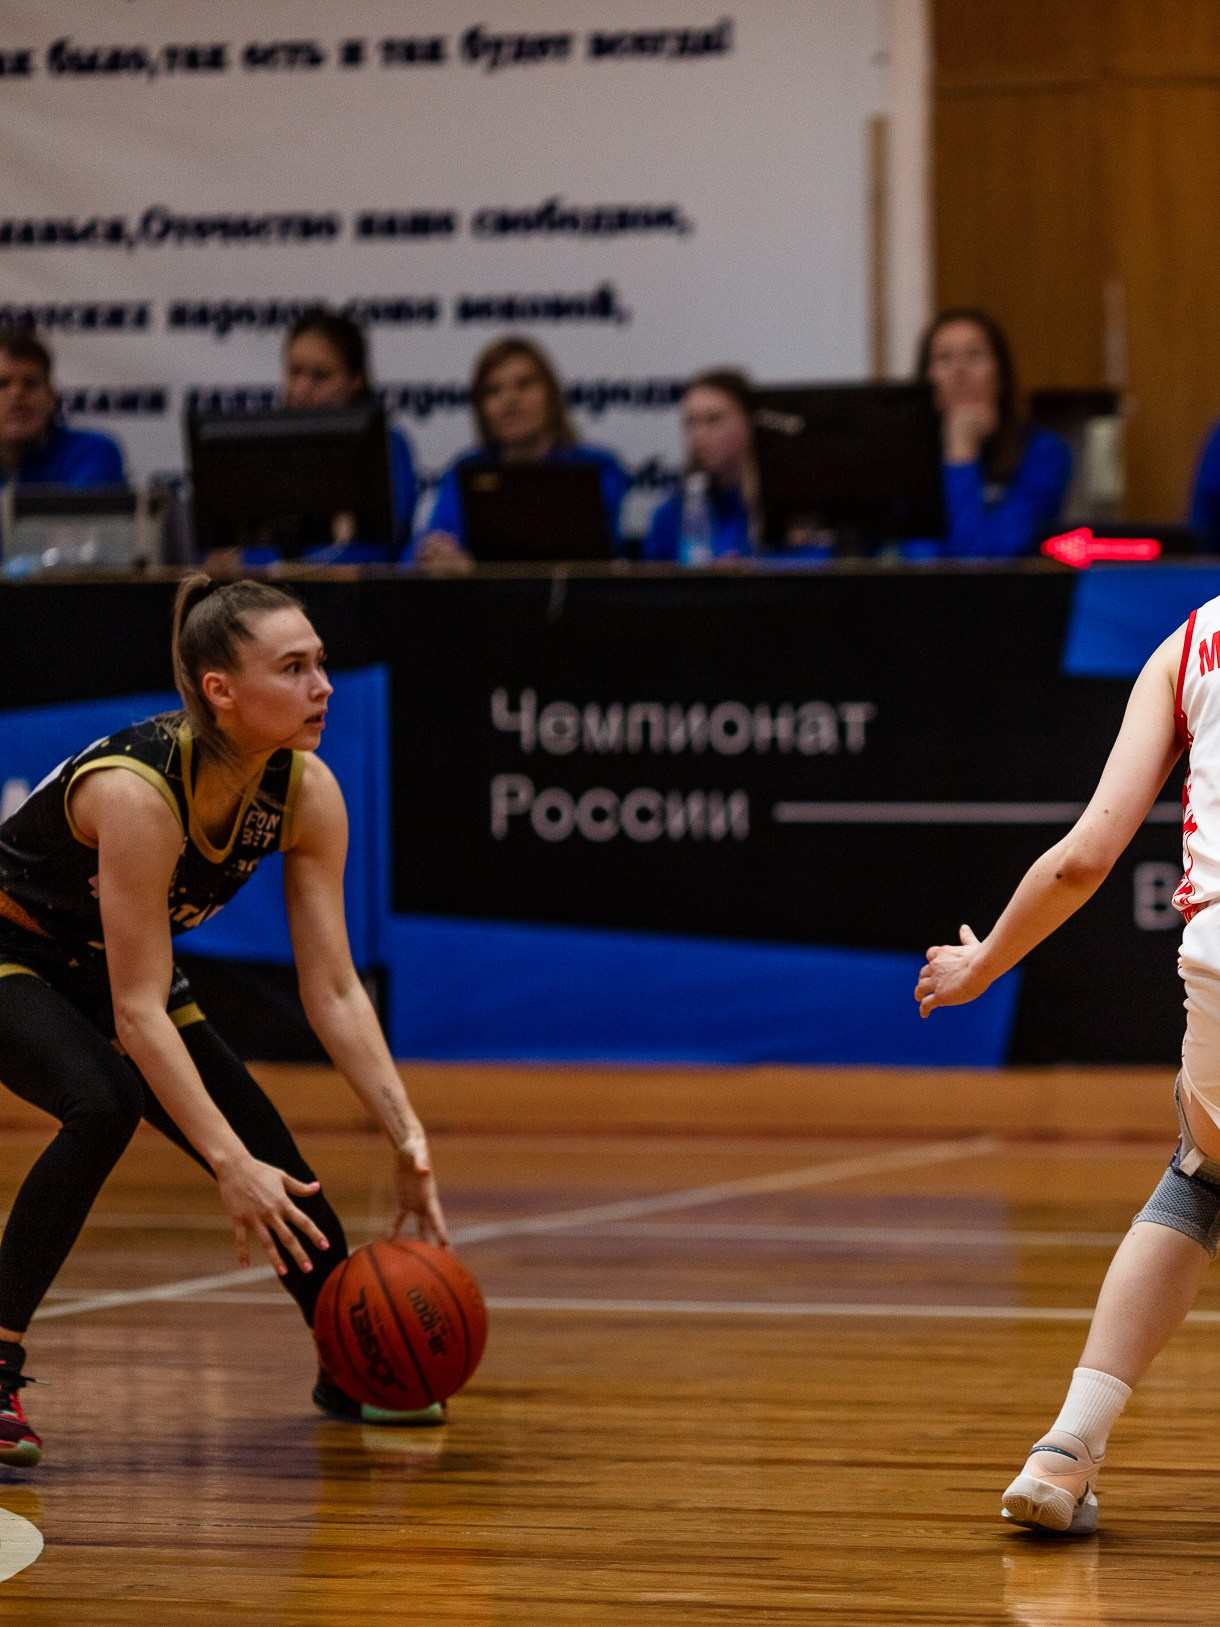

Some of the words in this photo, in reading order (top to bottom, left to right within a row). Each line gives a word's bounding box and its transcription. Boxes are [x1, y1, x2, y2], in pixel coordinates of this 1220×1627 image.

[491, 687, 877, 756] Чемпионат
[244, 809, 281, 833] FON
[491, 773, 750, 842] России
